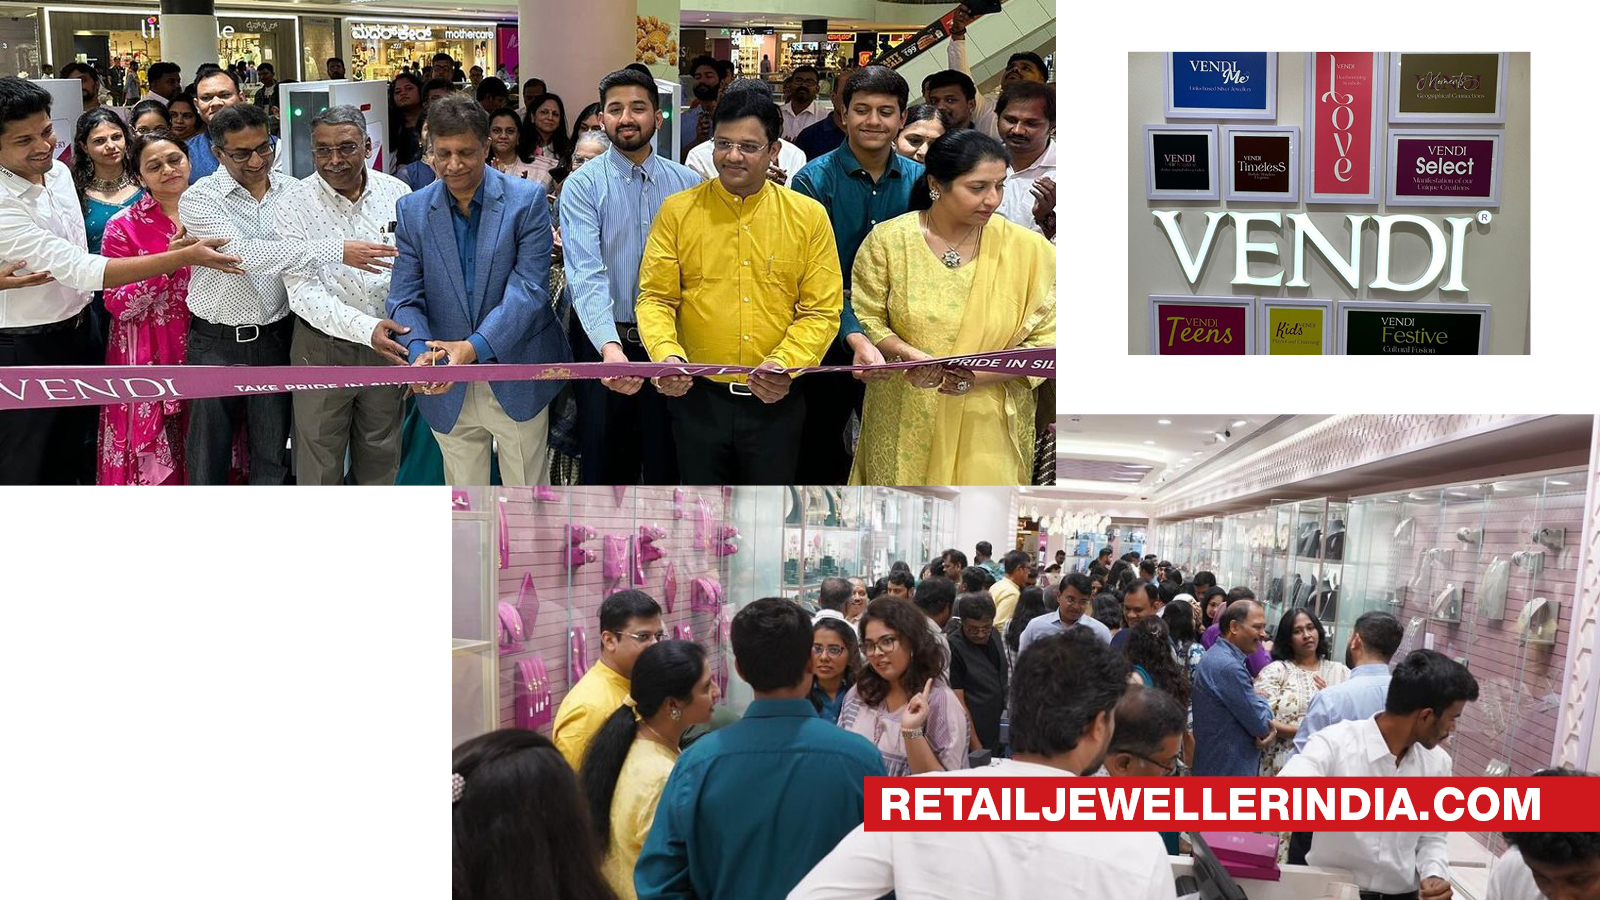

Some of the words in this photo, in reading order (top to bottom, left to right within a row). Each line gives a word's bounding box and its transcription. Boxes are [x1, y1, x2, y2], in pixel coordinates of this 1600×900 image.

[444, 27, 494, 40] mothercare
[1189, 60, 1237, 72] VENDI
[1222, 70, 1250, 84] Me
[1427, 145, 1467, 156] VENDI
[1163, 154, 1196, 163] VENDI
[1415, 156, 1475, 175] Select
[1412, 176, 1454, 184] Manifestation
[1417, 183, 1438, 192] Unique
[1151, 210, 1474, 292] VENDI
[1185, 317, 1219, 328] VENDI
[1381, 316, 1415, 327] VENDI
[1166, 316, 1233, 347] Teens
[1275, 321, 1304, 339] Kids
[1382, 326, 1449, 345] Festive
[1382, 345, 1410, 353] Cultural
[1411, 346, 1436, 354] Fusion
[947, 358, 1002, 368] PRIDE
[1005, 359, 1027, 369] IN
[0, 377, 184, 401] VENDI
[233, 384, 280, 392] TAKE
